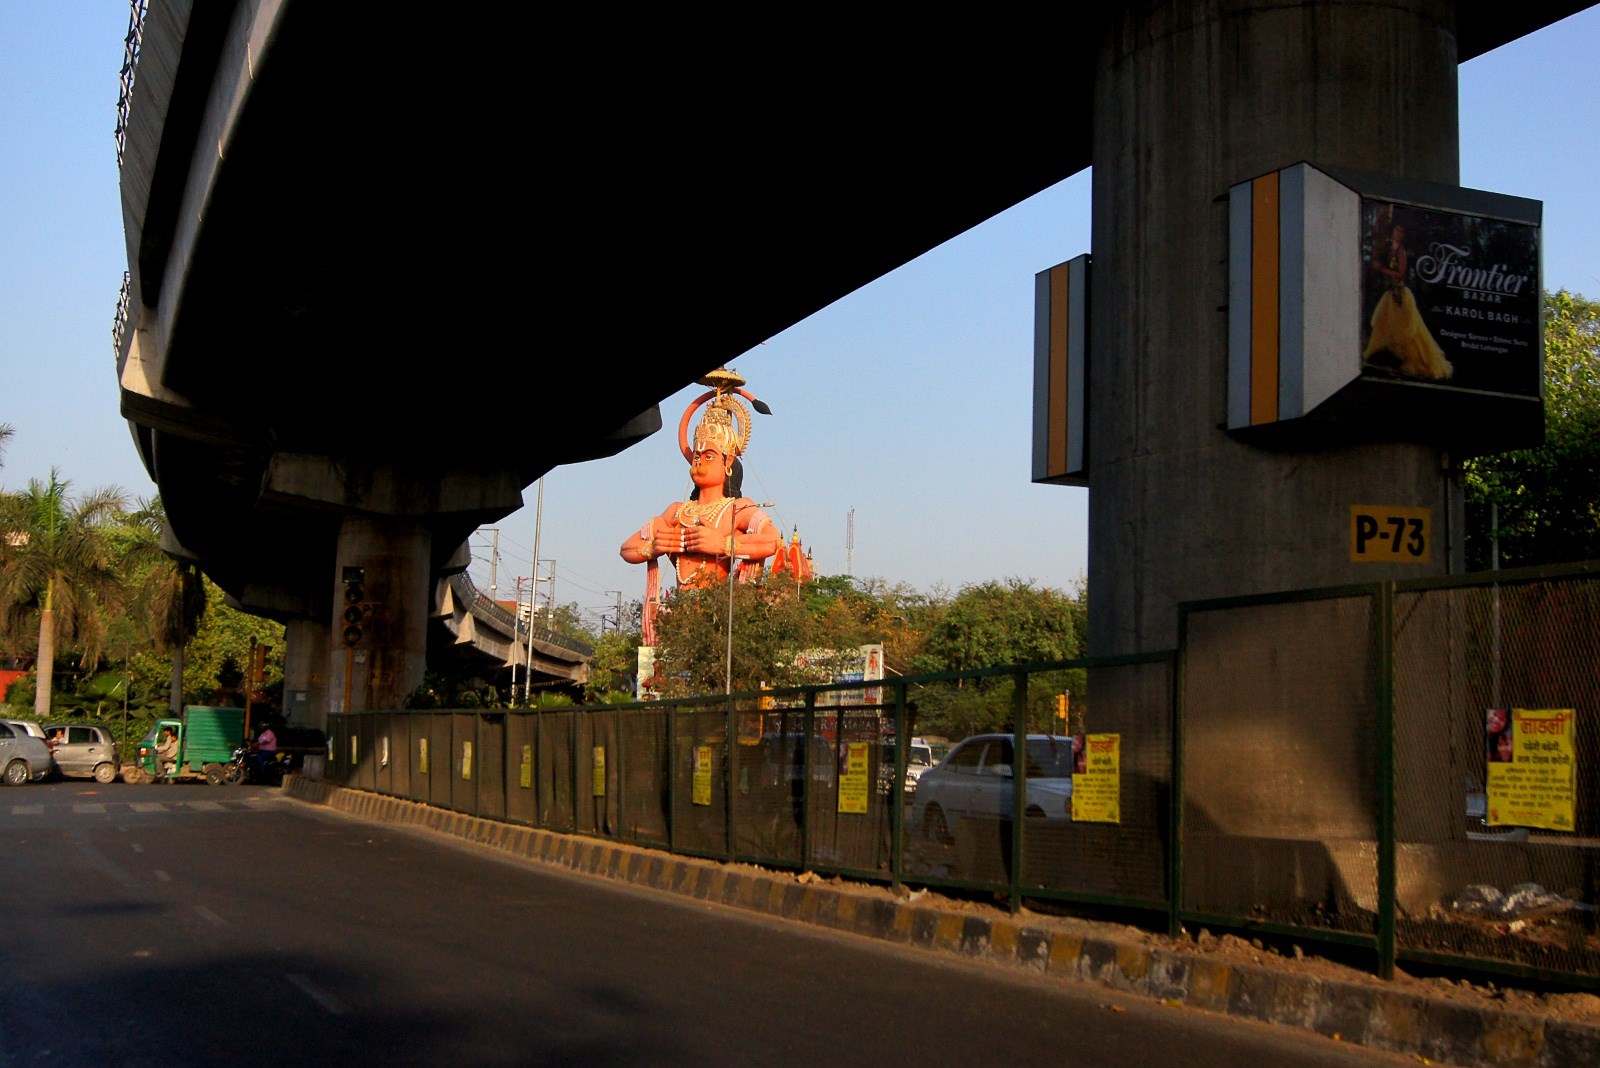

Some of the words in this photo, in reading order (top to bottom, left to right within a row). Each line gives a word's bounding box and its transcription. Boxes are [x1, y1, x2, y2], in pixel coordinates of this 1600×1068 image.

[1416, 242, 1528, 294] Frontier
[1463, 291, 1501, 303] BAZAR
[1445, 305, 1485, 320] KAROL
[1487, 311, 1519, 324] BAGH
[1356, 514, 1425, 557] P-73
